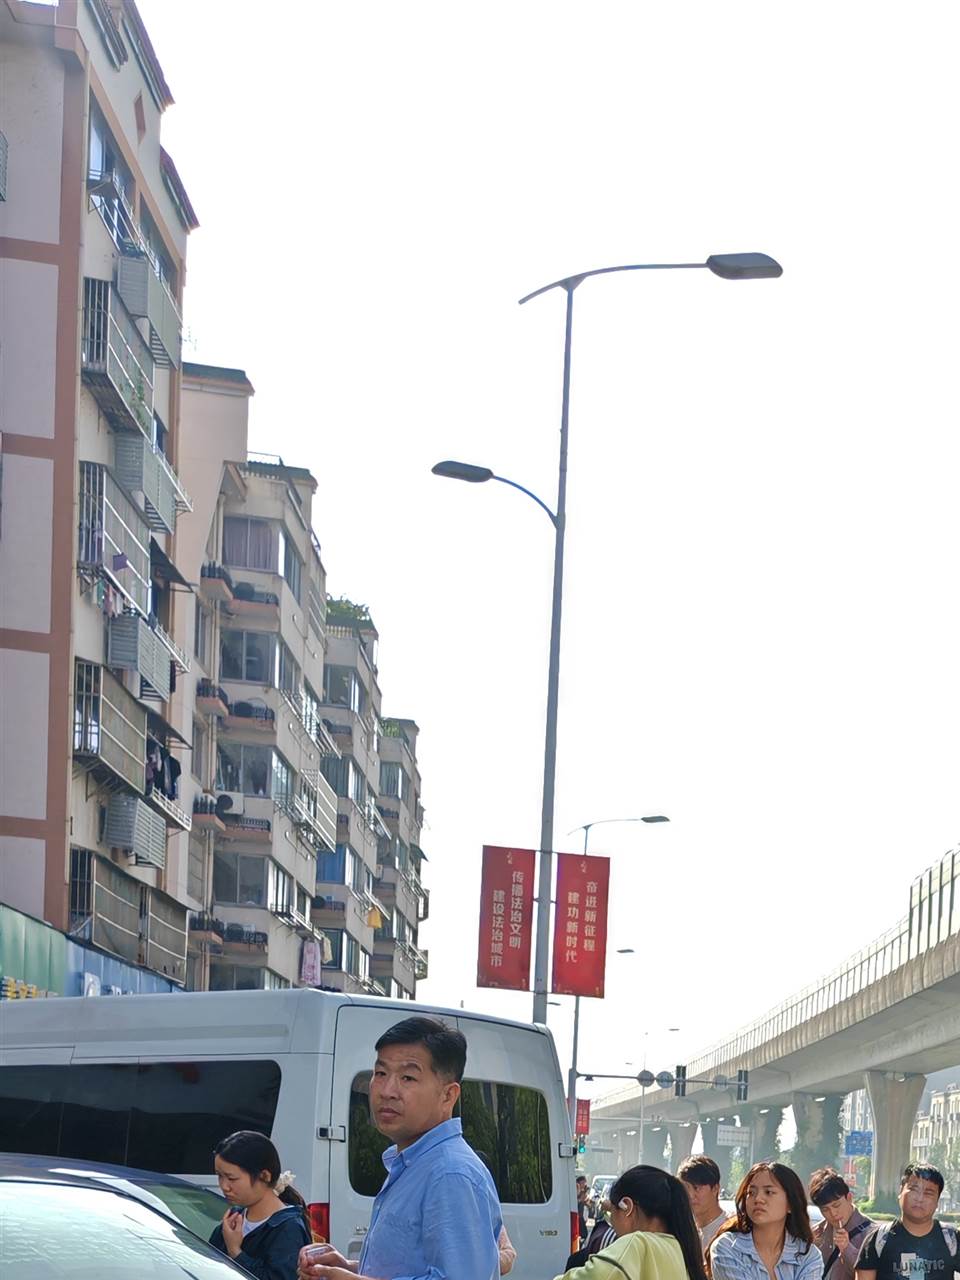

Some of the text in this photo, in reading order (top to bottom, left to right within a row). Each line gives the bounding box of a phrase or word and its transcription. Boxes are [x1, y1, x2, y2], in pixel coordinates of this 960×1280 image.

[490, 889, 506, 967] 建设法治城市
[509, 871, 524, 950] 传播法治文明
[565, 891, 580, 963] 建功新时代
[583, 881, 598, 952] 奋进新征程
[892, 1258, 945, 1273] LUNATIC
